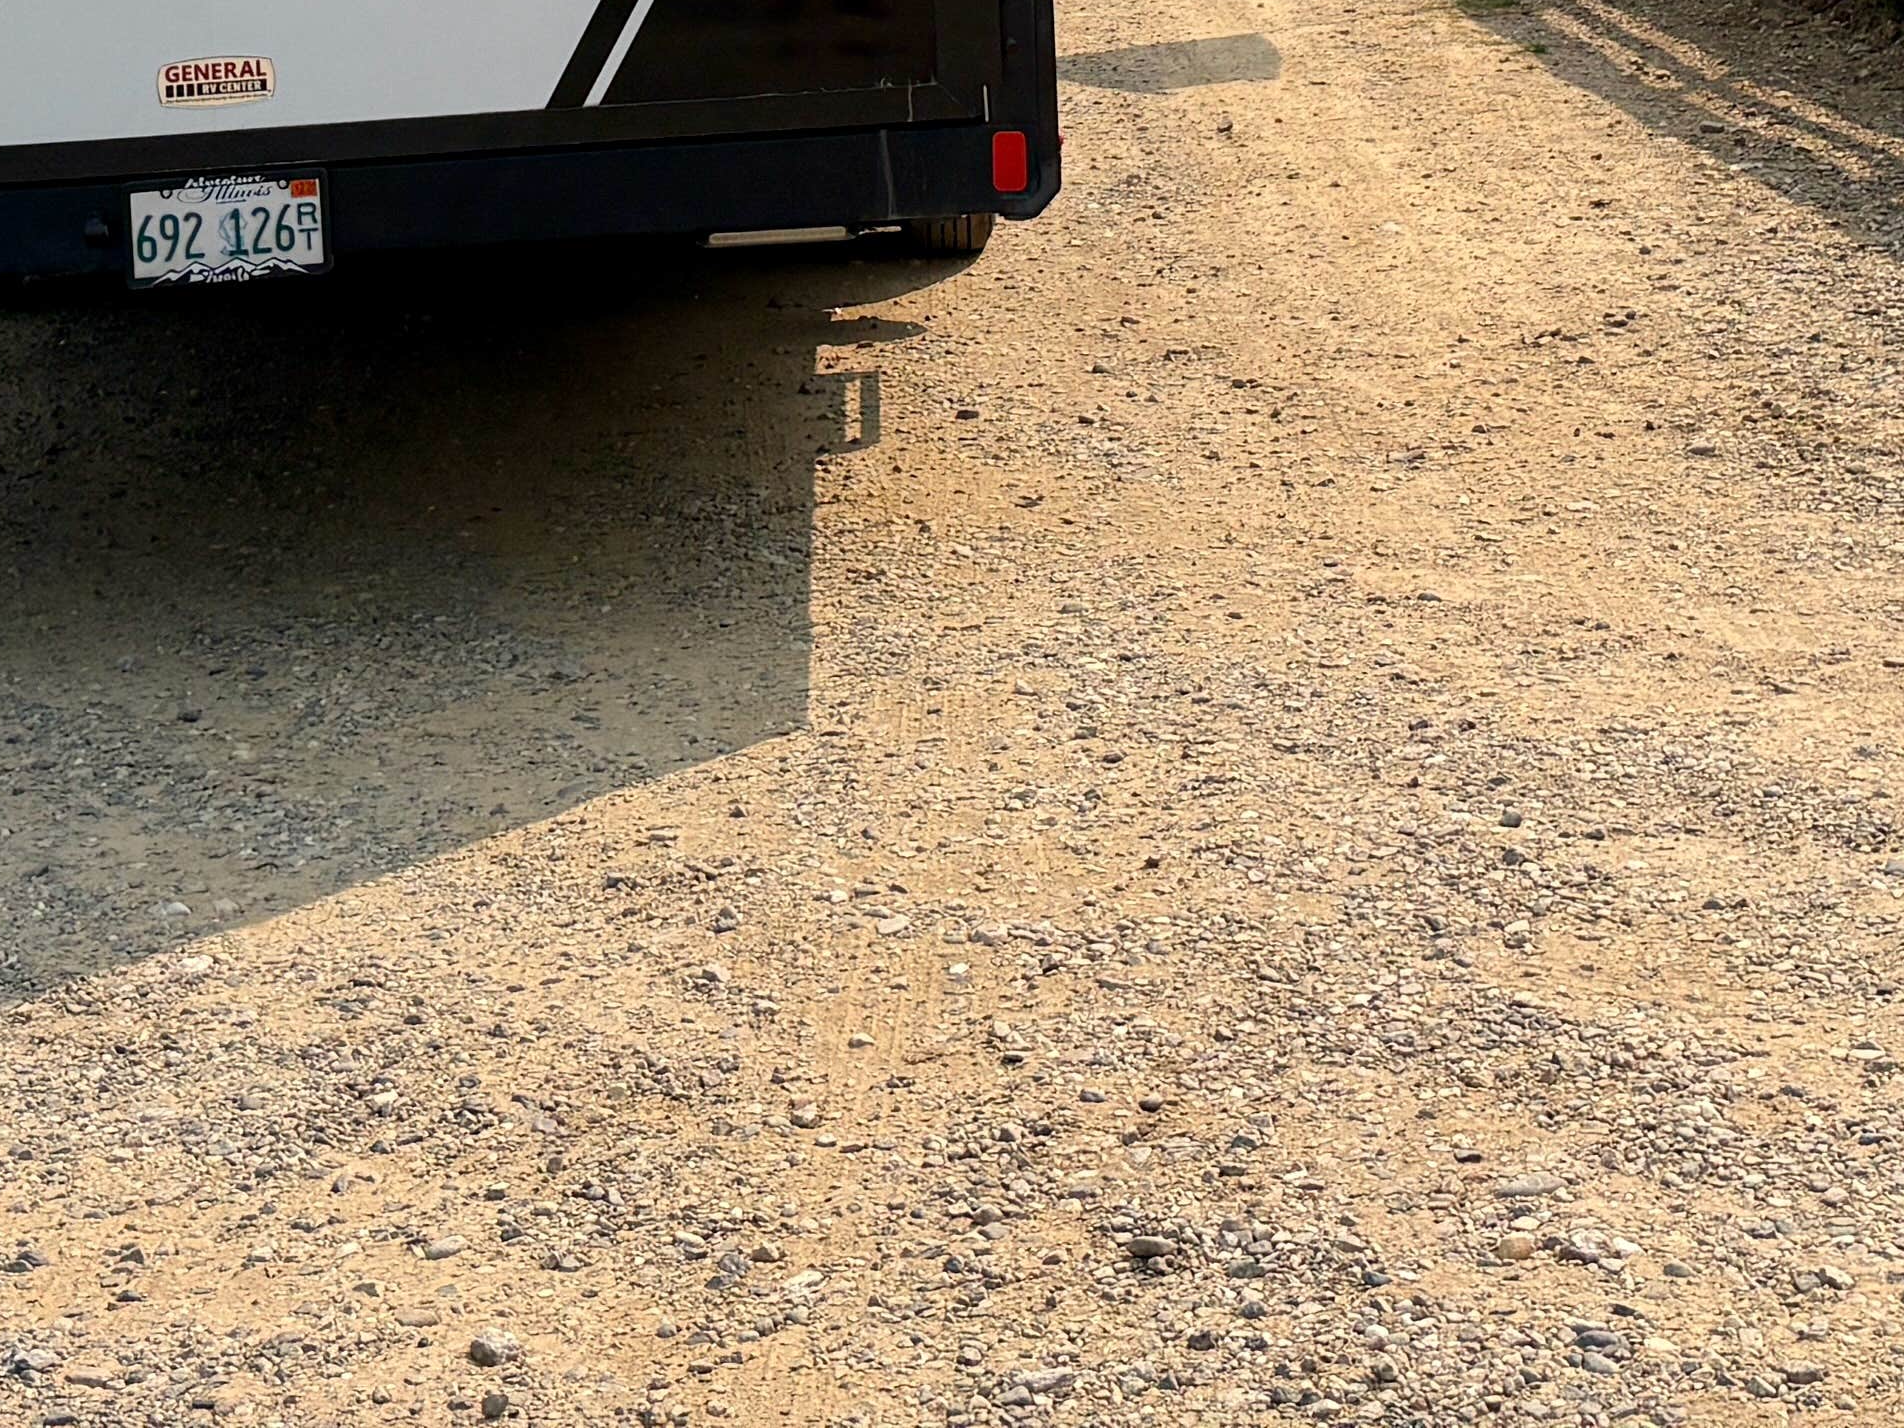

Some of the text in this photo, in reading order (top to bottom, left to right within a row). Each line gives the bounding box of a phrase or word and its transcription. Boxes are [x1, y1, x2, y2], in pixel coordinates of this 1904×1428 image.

[164, 59, 267, 83] GENERAL
[201, 80, 262, 94] RV CENTER
[136, 203, 296, 264] 692 126
